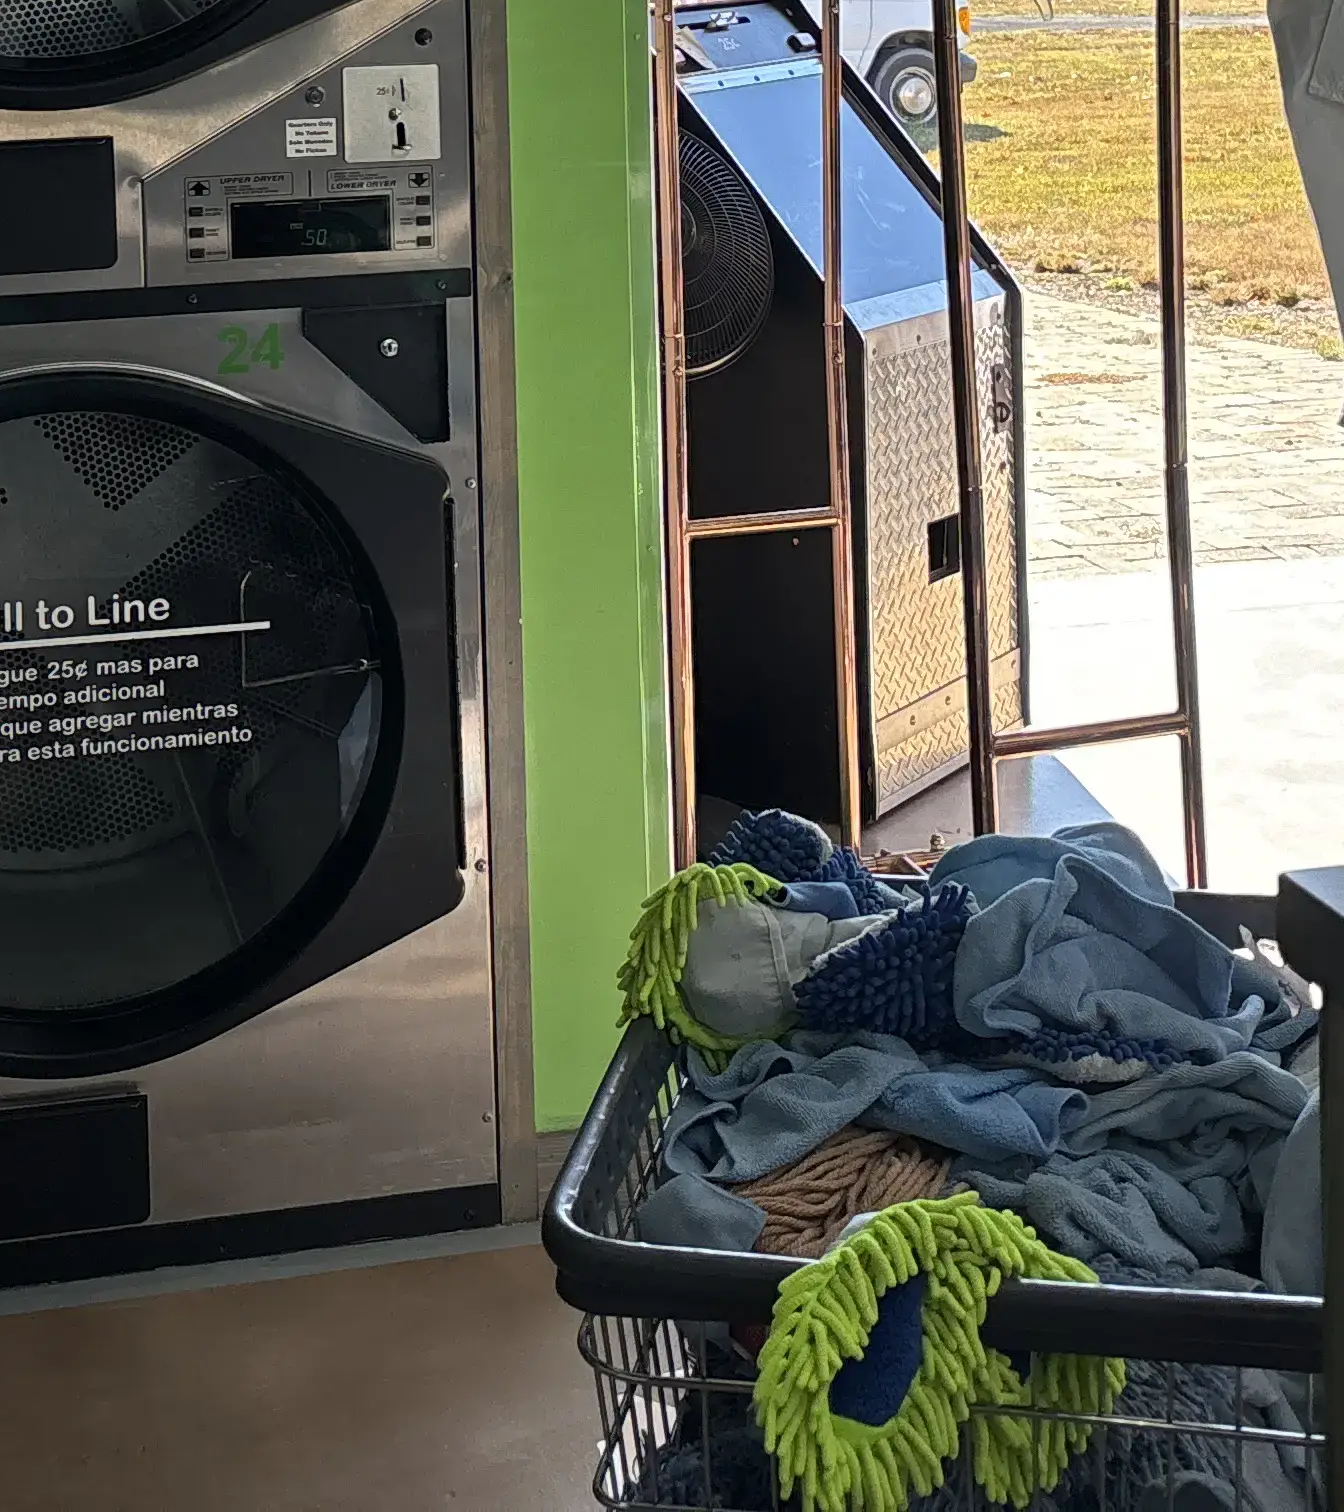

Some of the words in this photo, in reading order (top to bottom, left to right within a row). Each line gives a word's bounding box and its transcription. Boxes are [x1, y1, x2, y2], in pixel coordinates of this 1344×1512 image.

[220, 177, 251, 185] UPPER
[253, 175, 285, 183] DRYER
[331, 182, 364, 190] LOWER
[366, 180, 397, 188] DRYER
[217, 322, 285, 375] 24
[36, 600, 74, 630] to
[87, 593, 170, 626] Line
[47, 659, 89, 681] 25¢
[97, 659, 142, 677] mas
[149, 654, 199, 675] para
[63, 680, 165, 706] adicional
[0, 719, 42, 741] que
[50, 709, 137, 736] agregar
[142, 701, 239, 725] mientras
[27, 740, 76, 761] esta
[82, 726, 253, 756] funcionamiento
